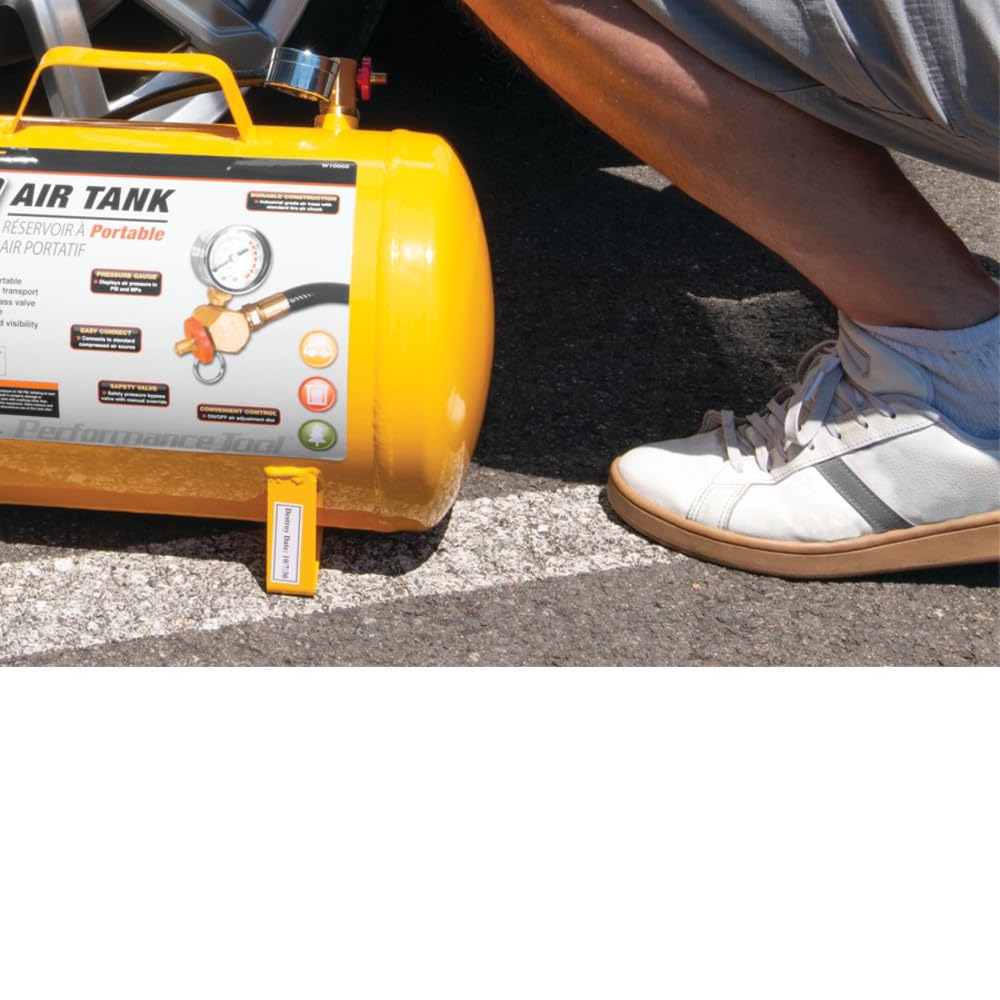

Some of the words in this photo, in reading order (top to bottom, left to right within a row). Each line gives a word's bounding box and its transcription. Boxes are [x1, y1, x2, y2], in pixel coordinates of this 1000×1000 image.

[10, 182, 74, 208] AIR
[84, 186, 176, 213] TANK
[2, 218, 74, 237] RÉSERVOIR
[76, 222, 85, 238] À
[90, 224, 165, 242] Portable
[0, 240, 22, 255] AIR
[23, 241, 86, 258] PORTATIF
[2, 286, 38, 296] transport
[15, 298, 36, 306] valve
[6, 320, 39, 330] visibility
[100, 328, 132, 336] CONNECT
[200, 406, 243, 414] CONVENIENT
[244, 408, 278, 416] CONTROL
[14, 419, 216, 450] Performance
[220, 431, 287, 456] Tool
[282, 508, 292, 533] Destroy
[282, 535, 291, 554] Date:
